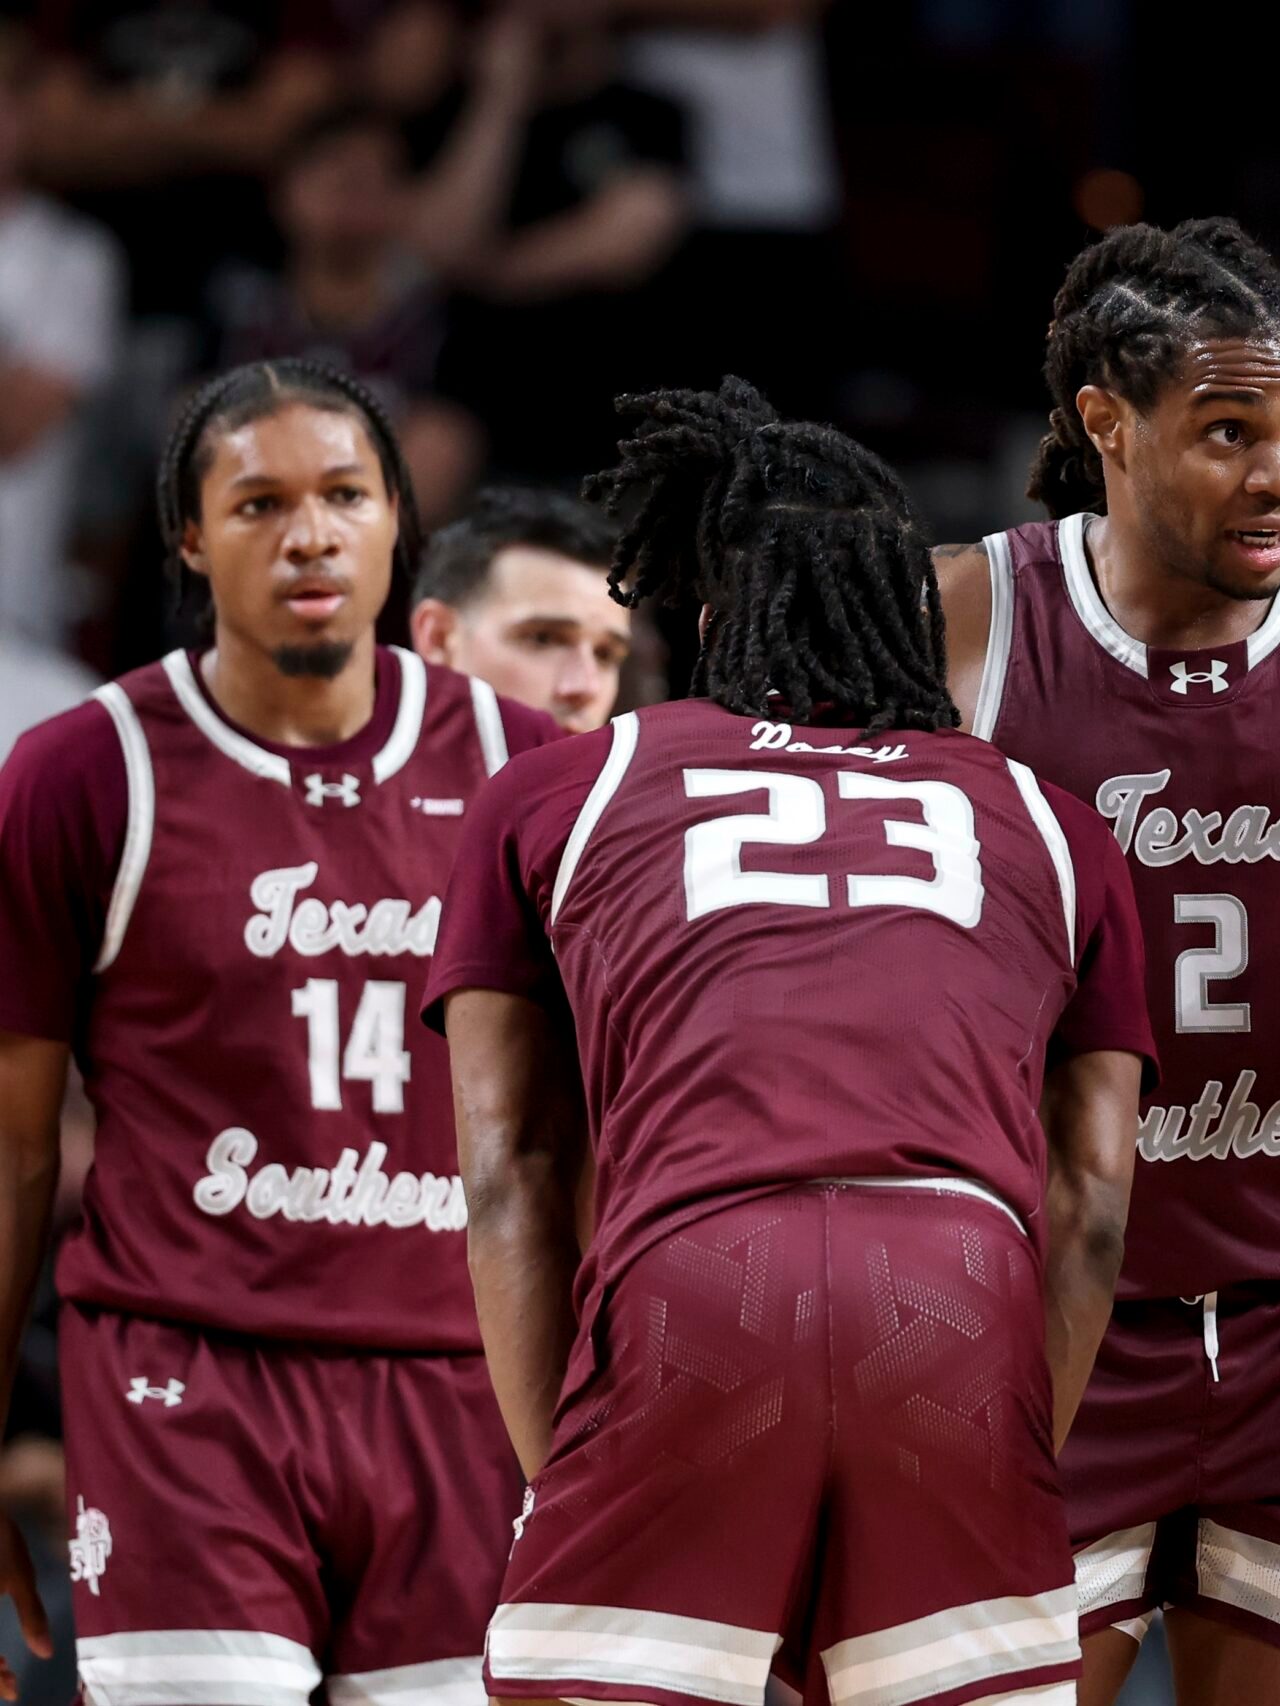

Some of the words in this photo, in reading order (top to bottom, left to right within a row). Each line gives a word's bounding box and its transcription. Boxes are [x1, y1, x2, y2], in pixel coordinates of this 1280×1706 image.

[244, 861, 442, 958] Texas
[682, 768, 985, 929] 23
[1173, 893, 1252, 1034] 2
[291, 977, 411, 1114] 14
